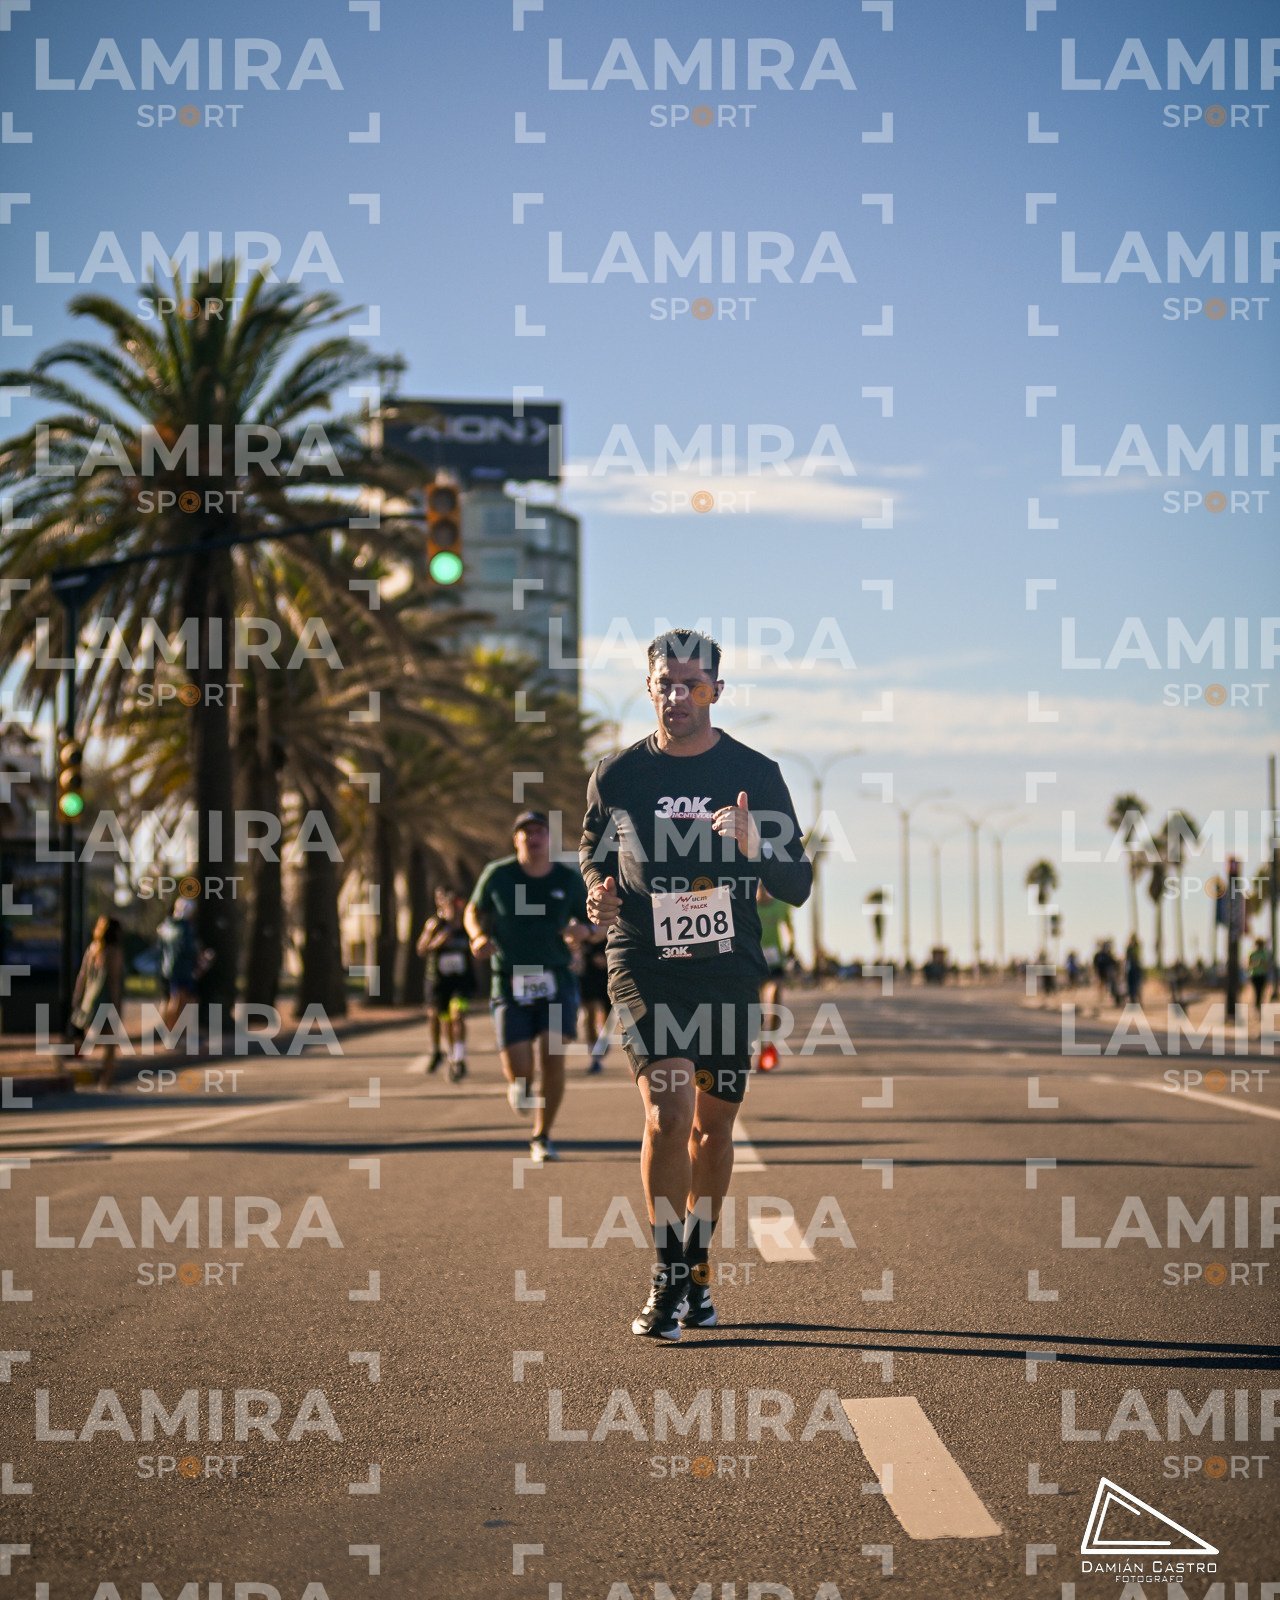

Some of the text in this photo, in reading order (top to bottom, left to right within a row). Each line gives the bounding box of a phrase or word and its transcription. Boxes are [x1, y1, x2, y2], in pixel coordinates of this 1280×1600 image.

[655, 797, 712, 818] 30K
[660, 910, 729, 941] 1208
[662, 946, 689, 959] 30K
